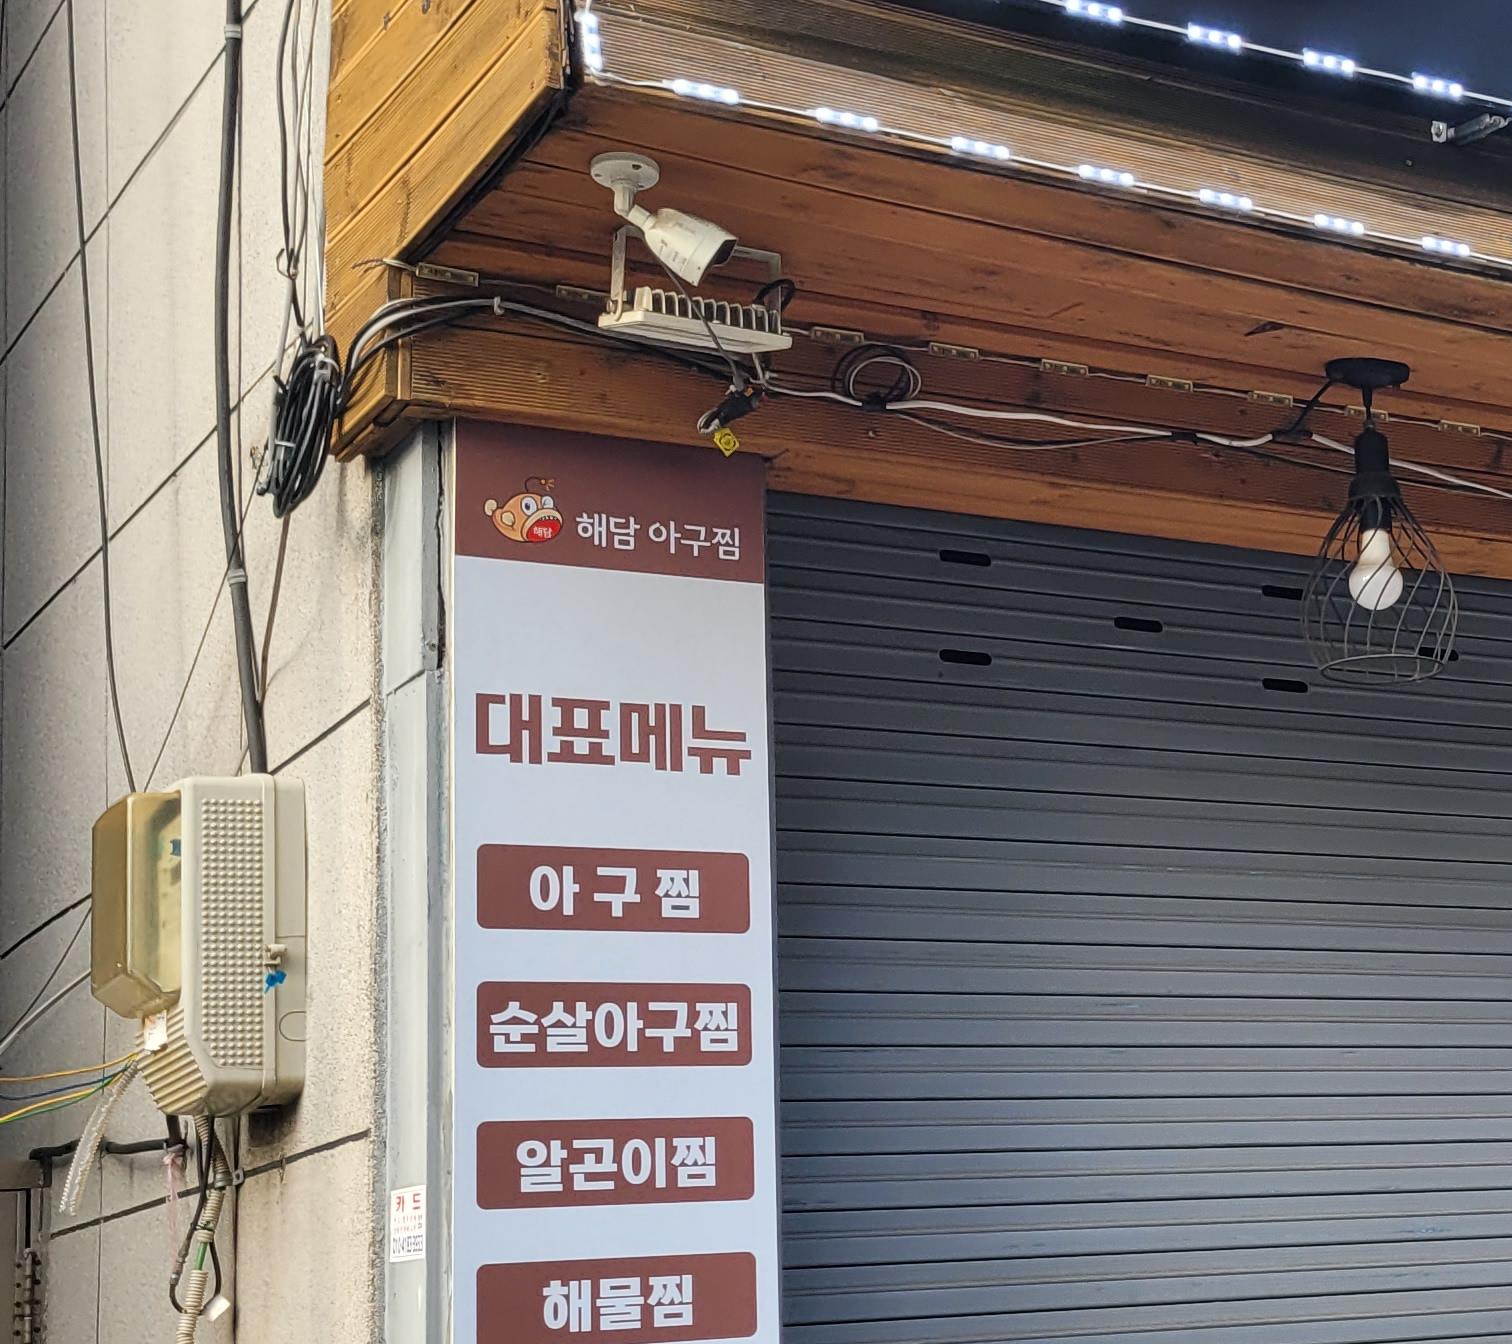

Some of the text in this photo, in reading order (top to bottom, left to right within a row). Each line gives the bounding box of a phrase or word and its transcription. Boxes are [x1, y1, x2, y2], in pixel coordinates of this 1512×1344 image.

[575, 512, 741, 561] 해담 아구찜
[475, 692, 752, 776] 대표메뉴
[489, 1001, 739, 1053] 순살아구찜
[516, 1136, 717, 1193] 알곤이찜
[542, 1274, 694, 1333] 해물찜
